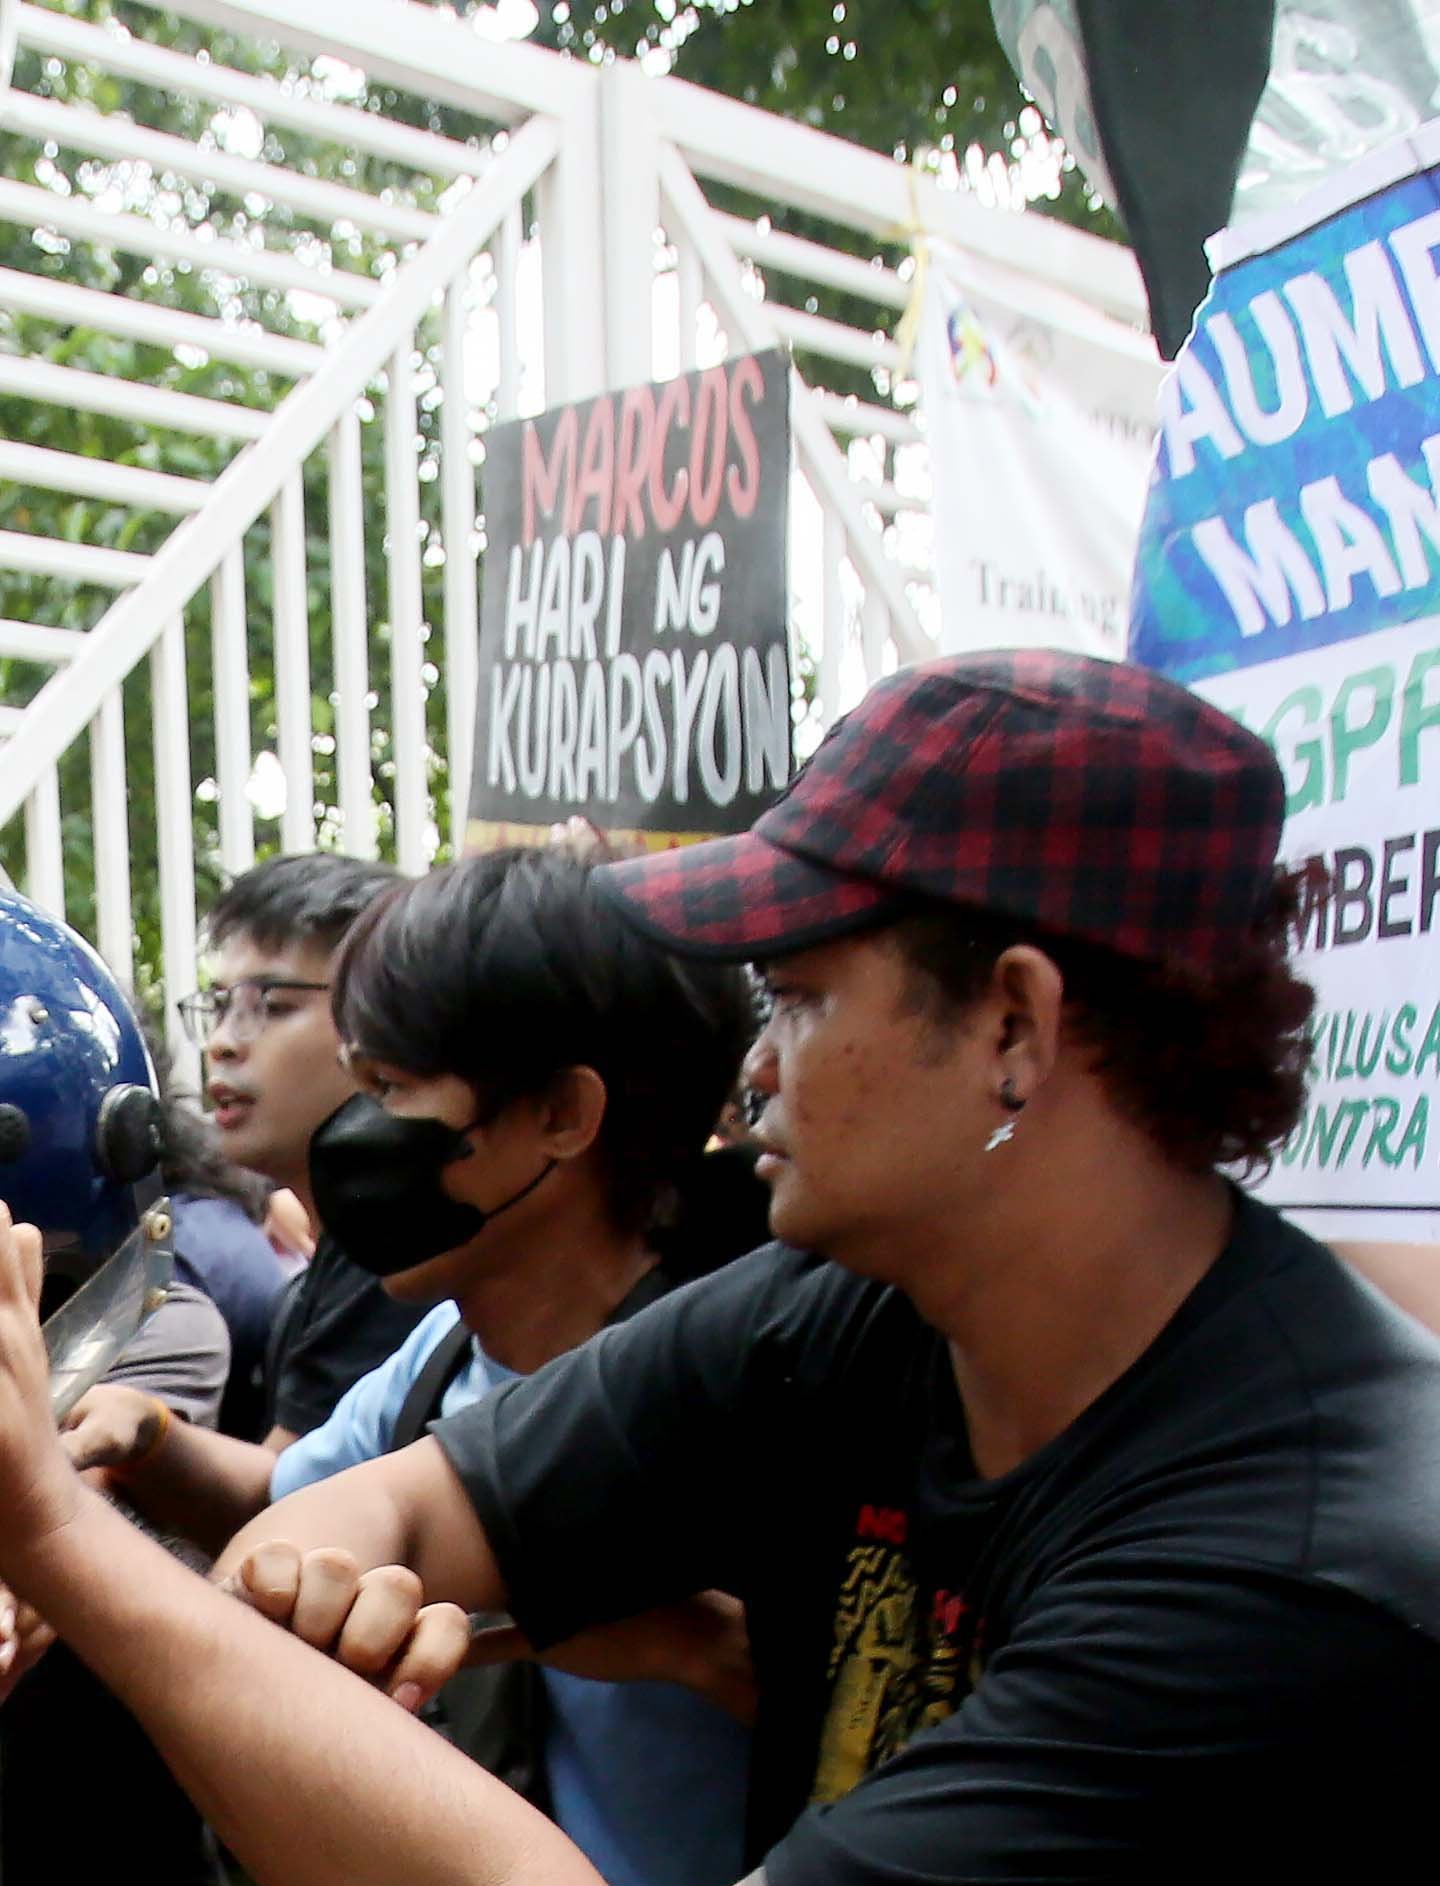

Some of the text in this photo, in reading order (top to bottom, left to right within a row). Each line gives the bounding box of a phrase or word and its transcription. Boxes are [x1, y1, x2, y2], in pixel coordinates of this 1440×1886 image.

[522, 355, 765, 549] MARCOS
[504, 530, 726, 662] HARI NG
[487, 642, 793, 807] KURAPSYON
